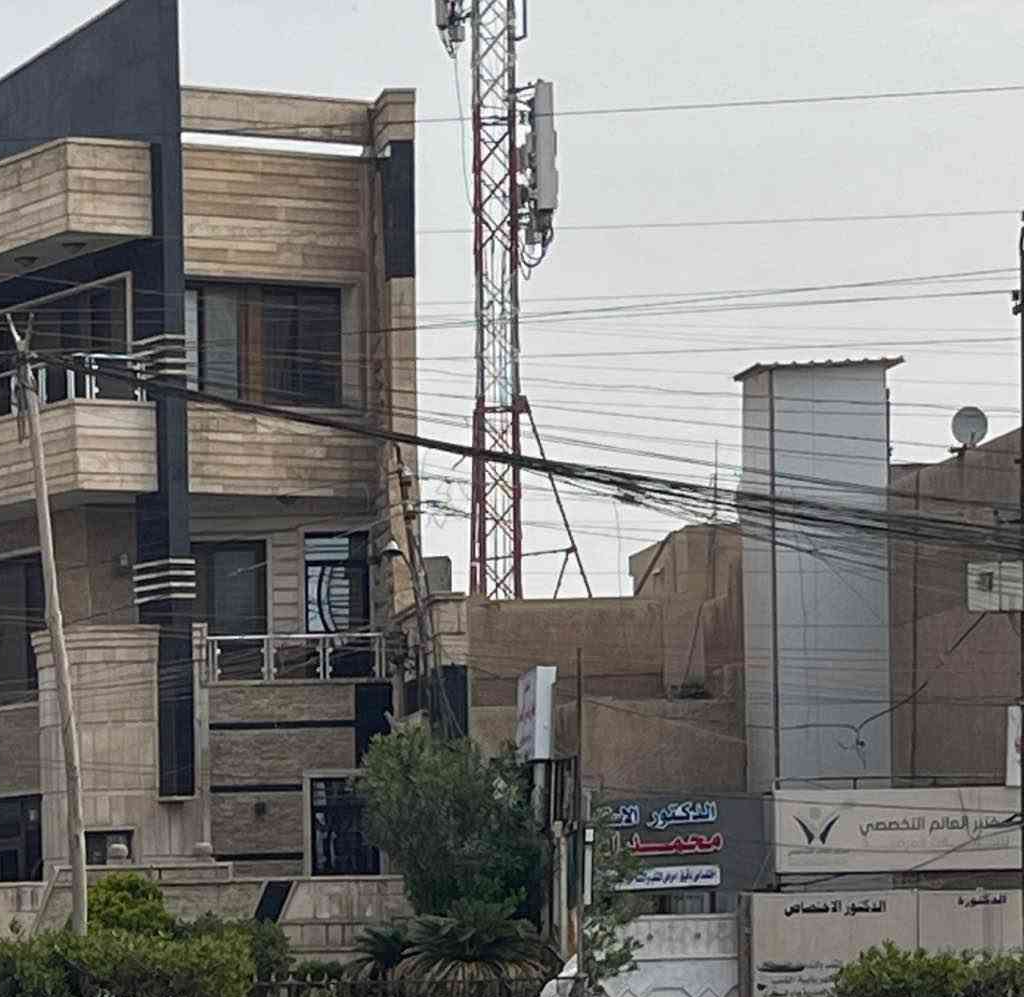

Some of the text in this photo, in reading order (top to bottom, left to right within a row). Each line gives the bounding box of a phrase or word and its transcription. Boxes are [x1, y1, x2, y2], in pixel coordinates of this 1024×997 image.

[646, 801, 718, 830] الدكتور
[859, 815, 926, 837] التخصصي
[929, 815, 969, 836] العالم
[843, 898, 887, 917] الدكتور
